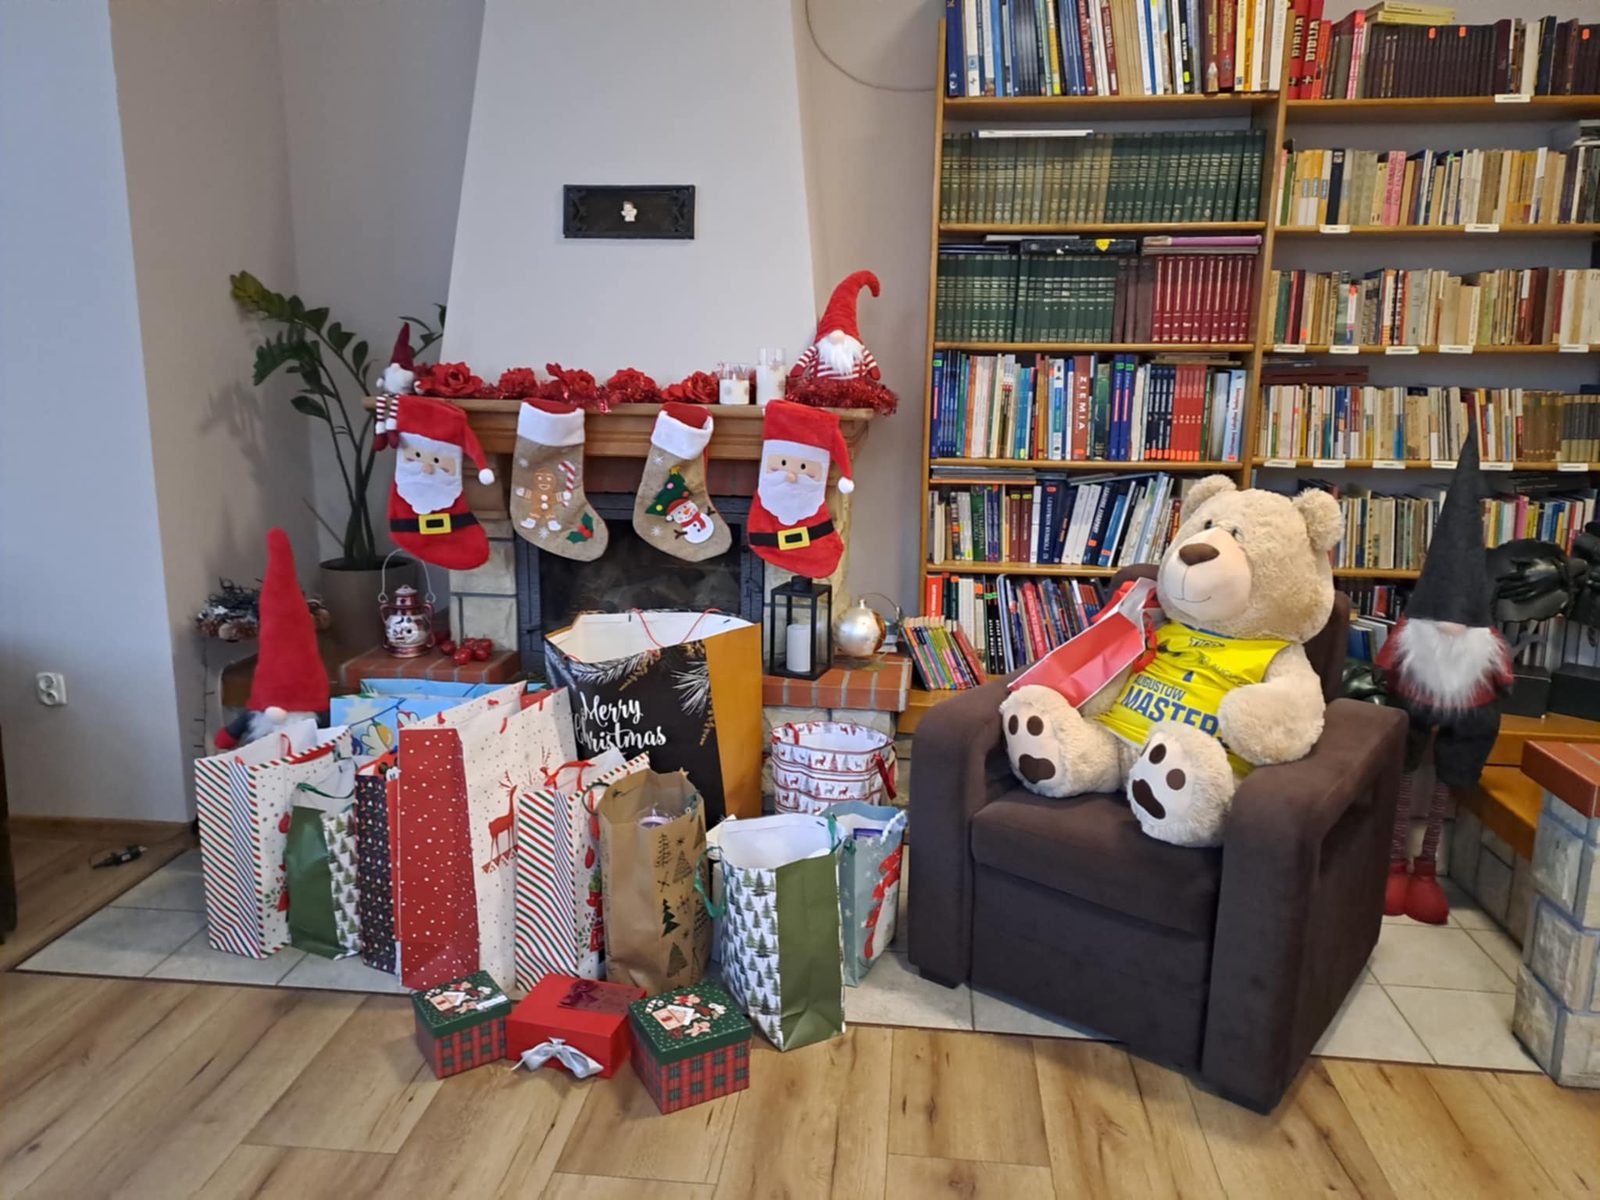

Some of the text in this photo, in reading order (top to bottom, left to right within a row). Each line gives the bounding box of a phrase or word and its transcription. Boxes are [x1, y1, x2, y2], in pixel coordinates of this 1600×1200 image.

[1304, 20, 1320, 62] BIBLIA
[1078, 376, 1088, 430] ZIEMIA
[580, 691, 644, 728] Merry
[1122, 685, 1219, 736] MASTER
[574, 711, 667, 752] Christmas
